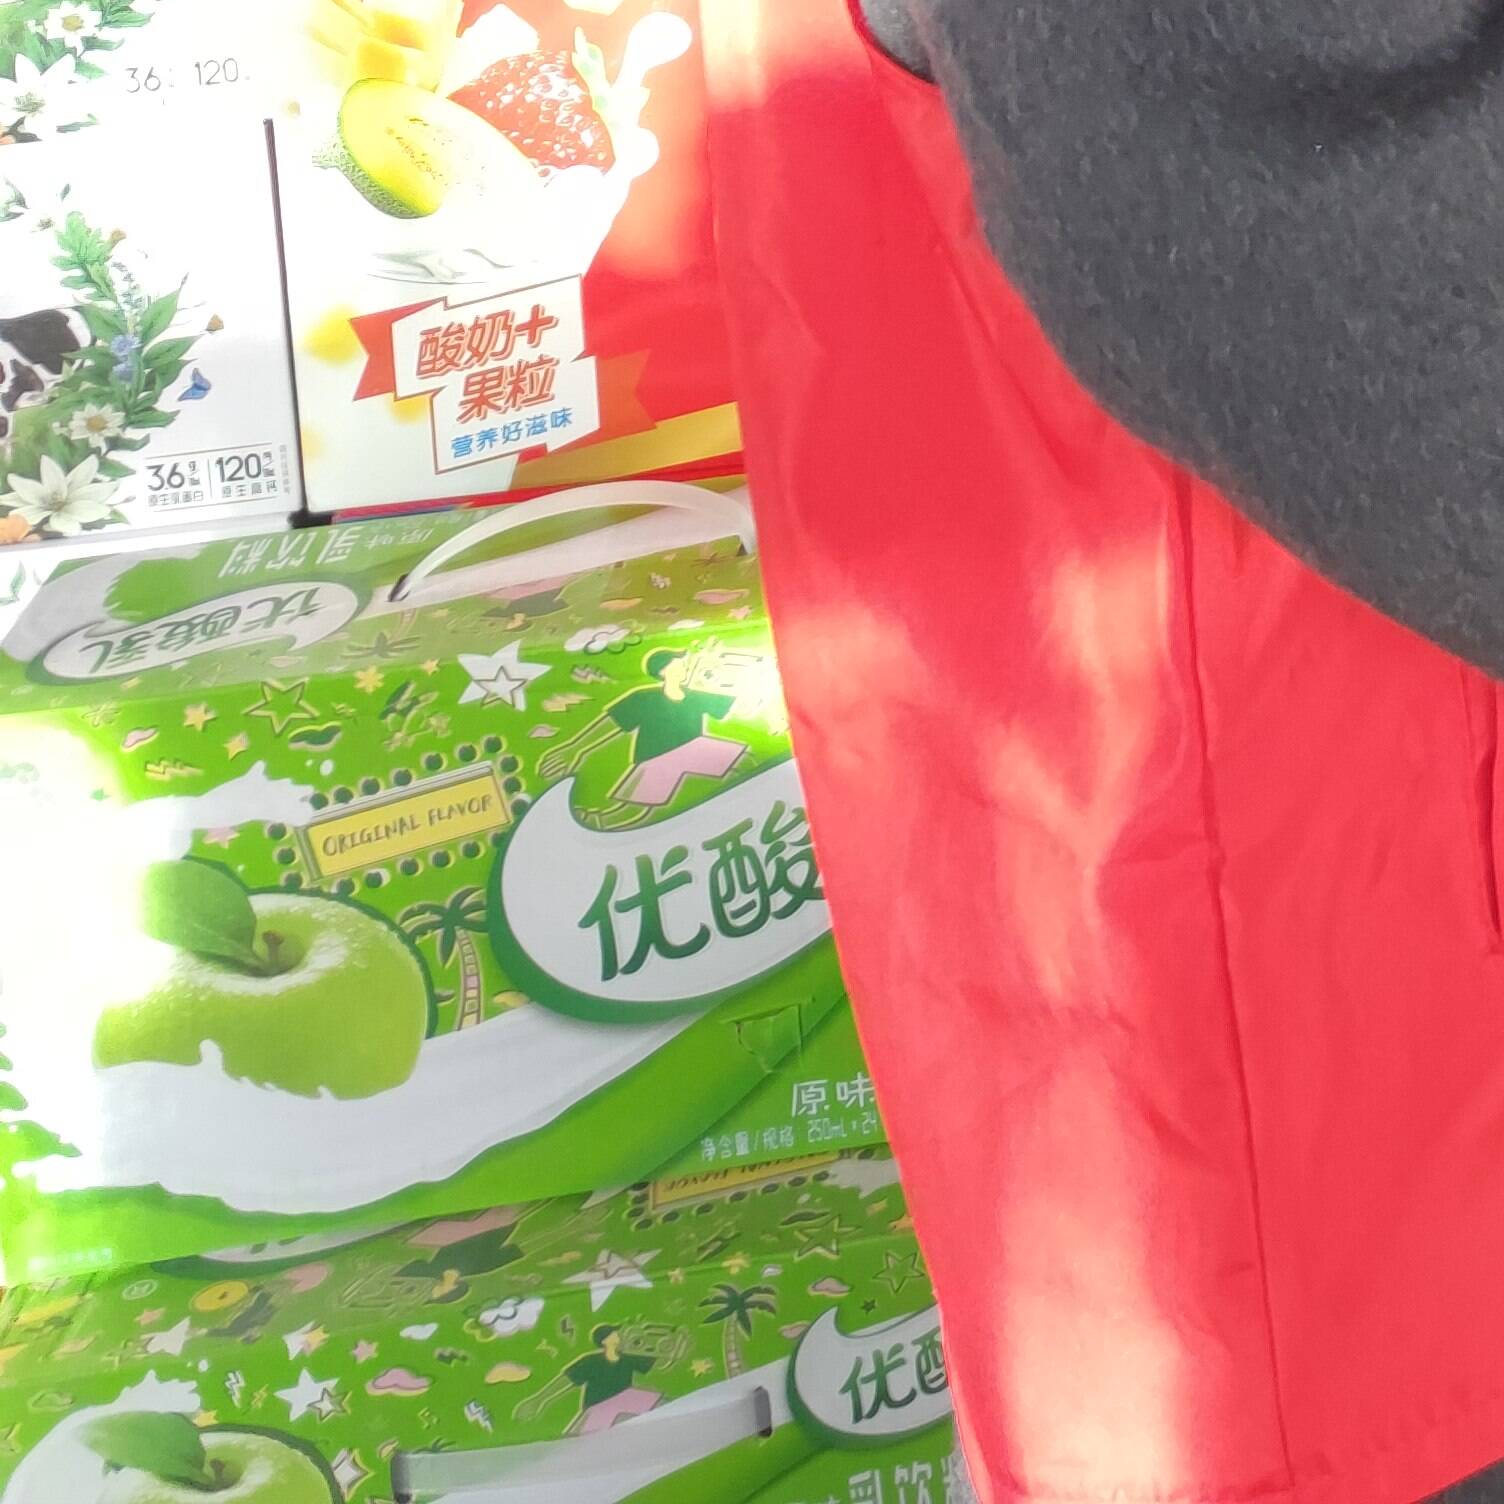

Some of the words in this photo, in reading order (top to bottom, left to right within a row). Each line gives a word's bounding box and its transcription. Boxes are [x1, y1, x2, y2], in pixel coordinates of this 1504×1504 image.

[195, 58, 239, 86] 120
[456, 353, 561, 425] 果粒
[451, 408, 573, 458] 营养好滋味
[78, 585, 325, 674] 优酸乳
[322, 814, 421, 857] ORIGINAL
[427, 793, 494, 827] FLAVOR
[791, 1071, 876, 1118] 原味
